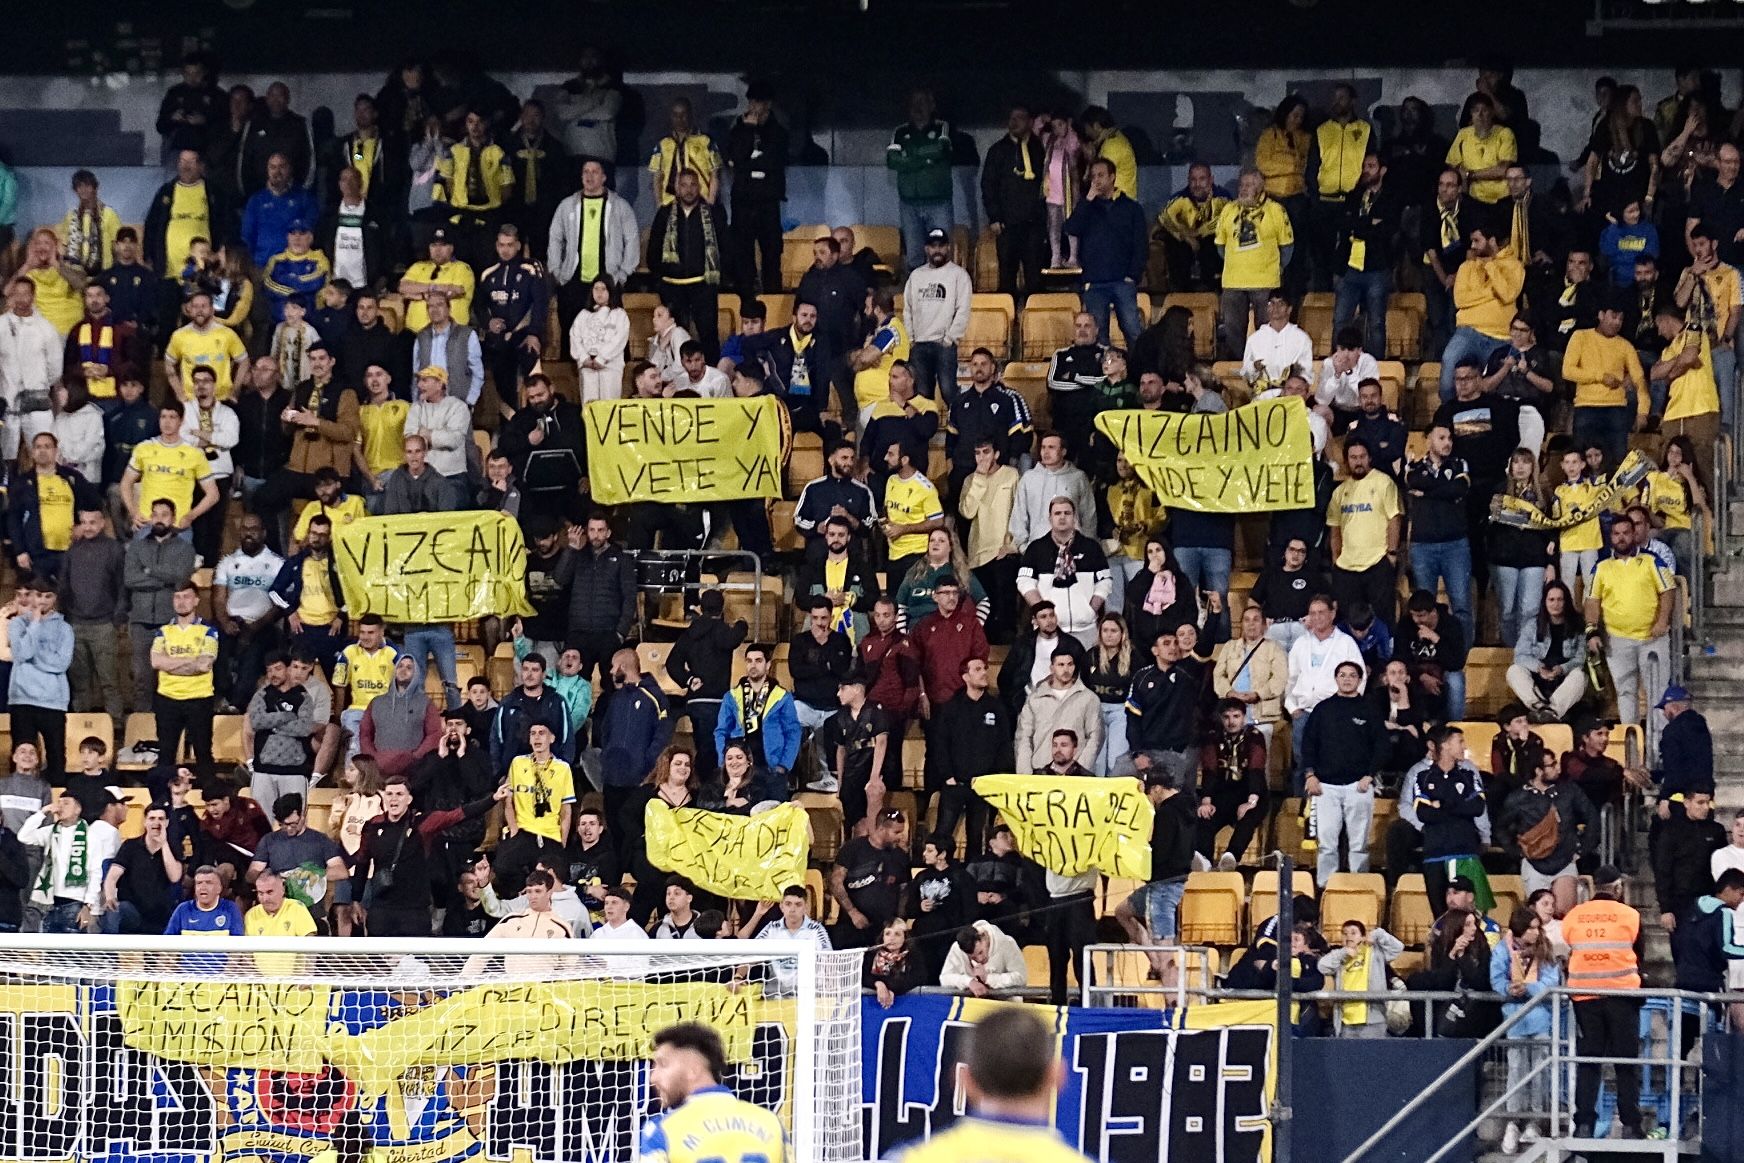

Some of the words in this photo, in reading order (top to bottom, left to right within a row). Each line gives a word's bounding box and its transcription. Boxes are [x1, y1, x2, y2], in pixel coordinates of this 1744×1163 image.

[590, 403, 719, 446] VENDE
[741, 405, 763, 441] Y
[617, 457, 716, 497] VETE
[1217, 465, 1233, 499] Y
[1244, 462, 1310, 504] VETE
[70, 830, 87, 877] Libre
[1586, 928, 1606, 938] 012
[1073, 1024, 1274, 1163] 1982
